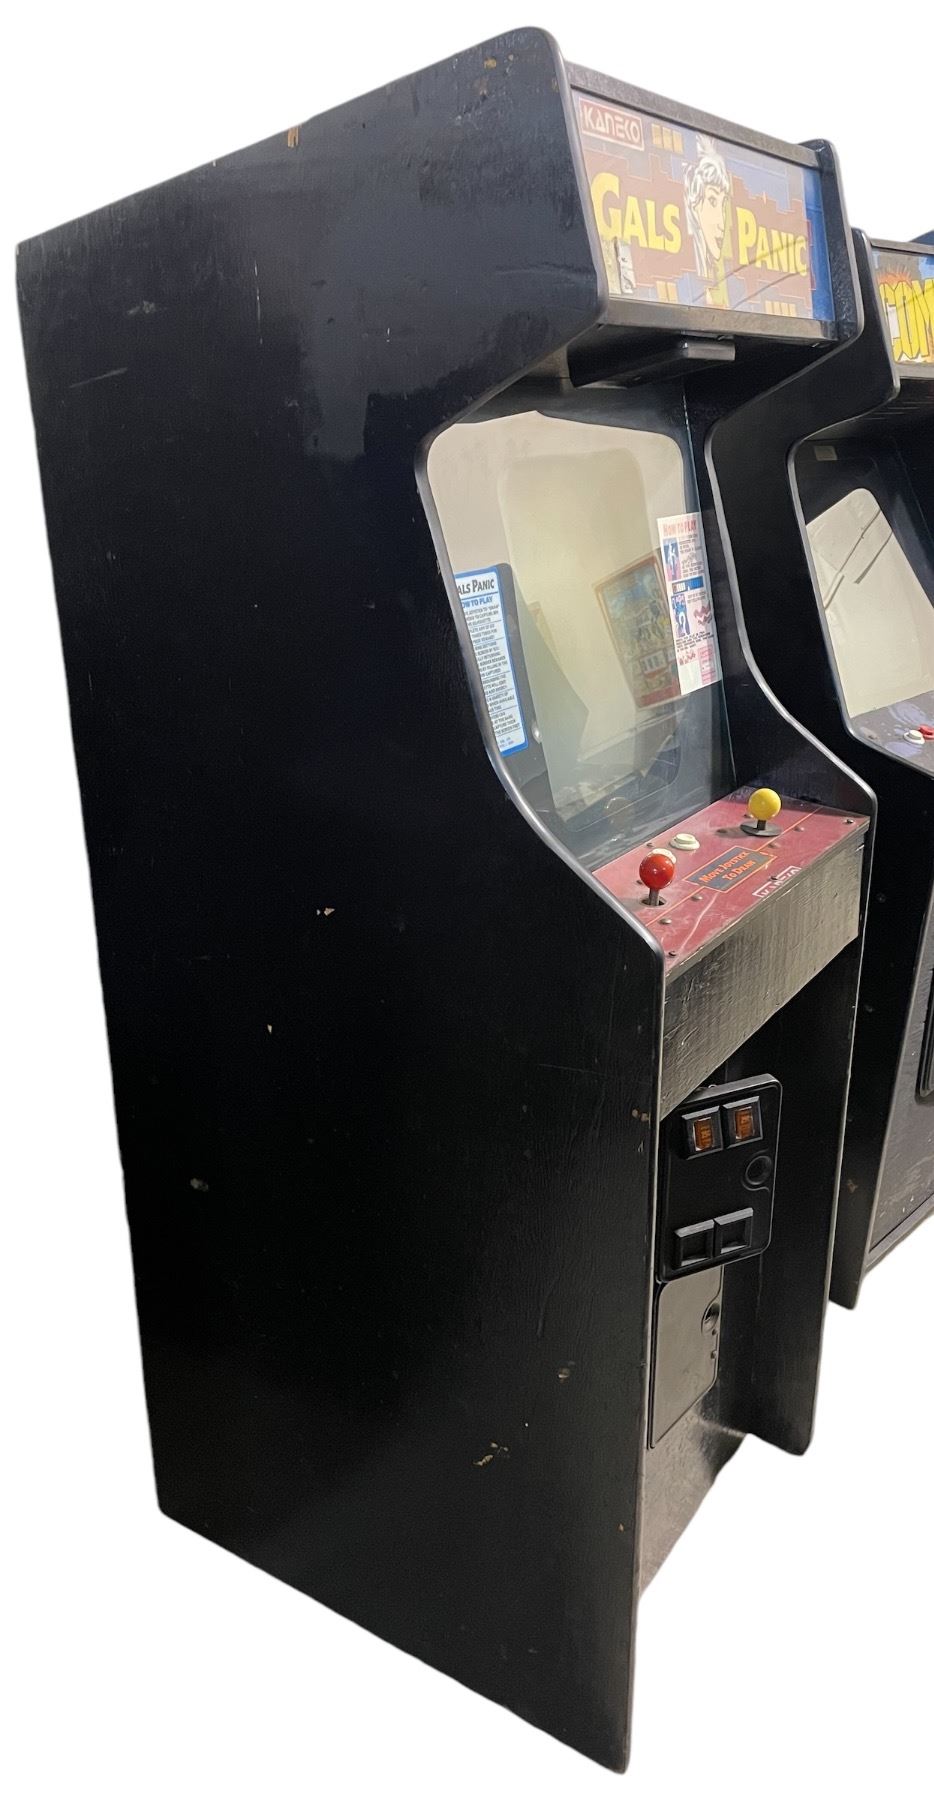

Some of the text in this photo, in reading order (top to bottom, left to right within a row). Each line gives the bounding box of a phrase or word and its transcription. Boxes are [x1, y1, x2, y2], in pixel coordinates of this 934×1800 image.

[583, 104, 641, 144] KANEKO
[590, 173, 810, 277] GALS PANIC
[684, 519, 697, 532] PLAY
[457, 578, 495, 595] ALS PANIC
[461, 600, 471, 609] OW
[471, 599, 479, 607] TO
[479, 596, 493, 605] PLAY
[699, 867, 724, 883] MOVE
[721, 871, 737, 881] TO
